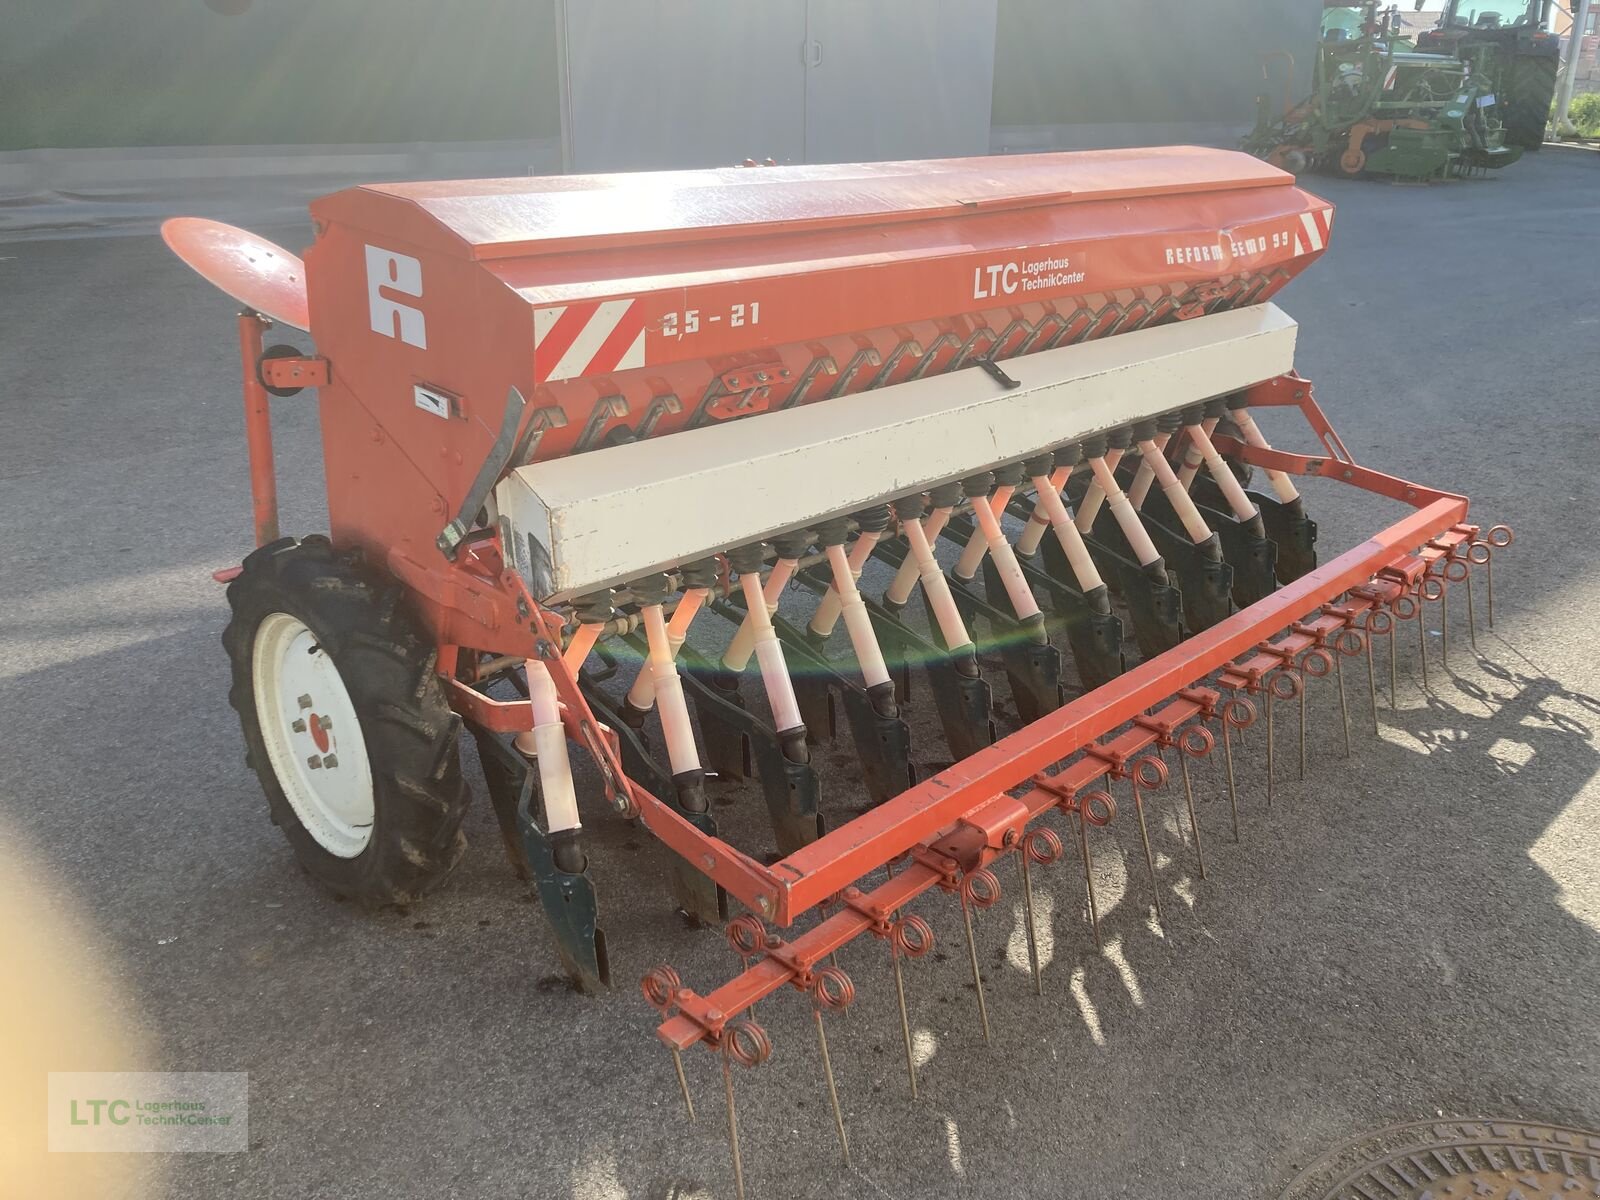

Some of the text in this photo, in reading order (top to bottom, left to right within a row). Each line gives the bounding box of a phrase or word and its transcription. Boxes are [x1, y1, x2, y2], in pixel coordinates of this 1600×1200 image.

[1165, 231, 1289, 265] REFORM SEMO 99
[1021, 257, 1069, 276] Lagerhaus
[973, 262, 1019, 299] LTC
[1021, 271, 1085, 291] TechnikCenter
